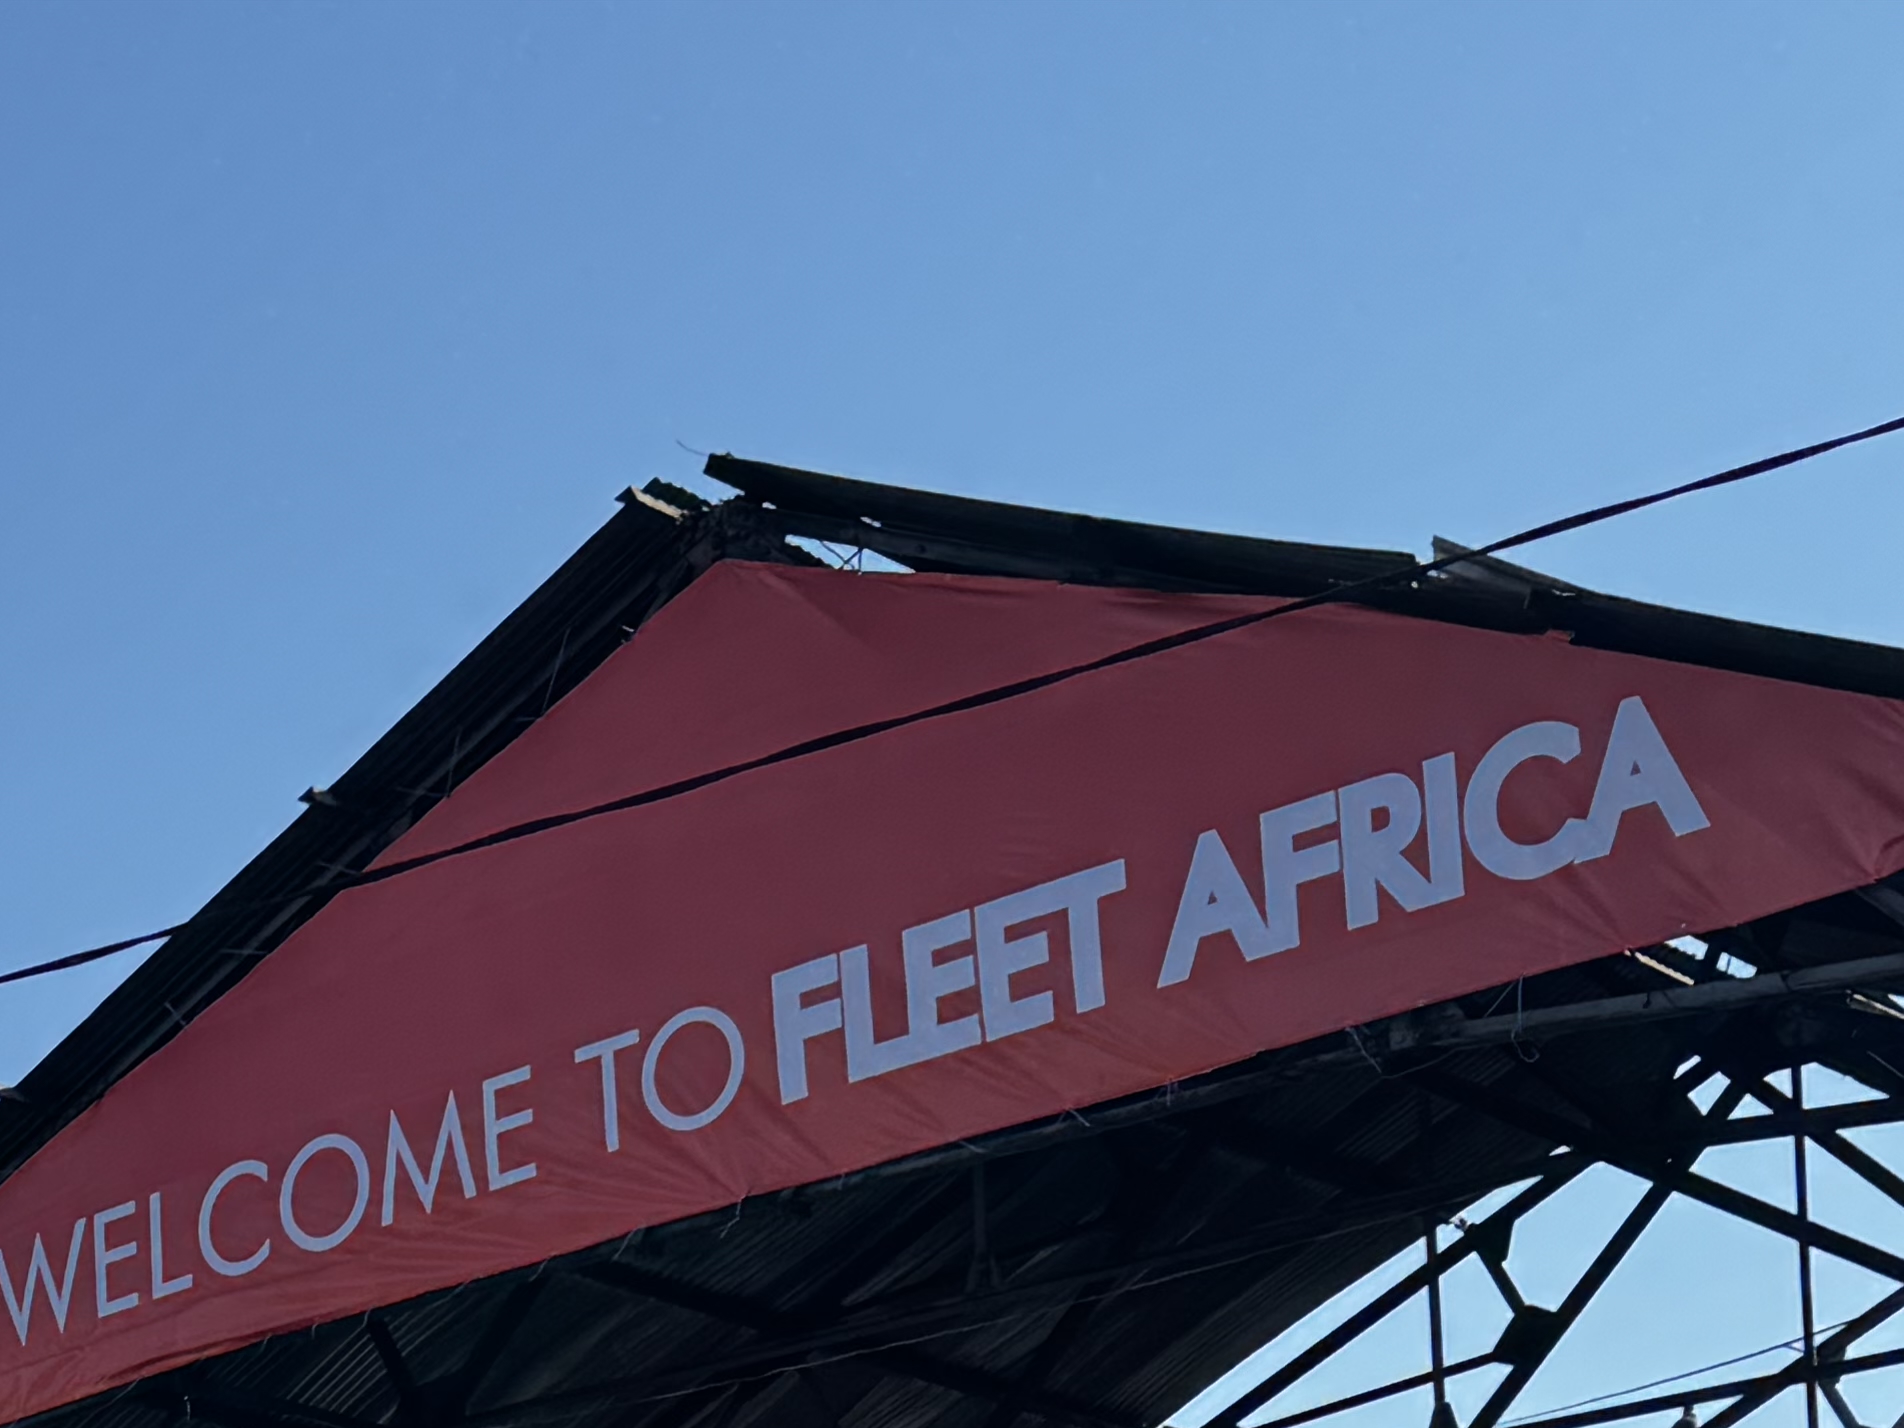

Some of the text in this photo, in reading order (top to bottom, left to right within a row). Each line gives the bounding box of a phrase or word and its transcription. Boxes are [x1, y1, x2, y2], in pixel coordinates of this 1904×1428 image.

[575, 1005, 745, 1152] TO
[771, 858, 1127, 1105] FLEET
[1157, 695, 1710, 988] AFRICA
